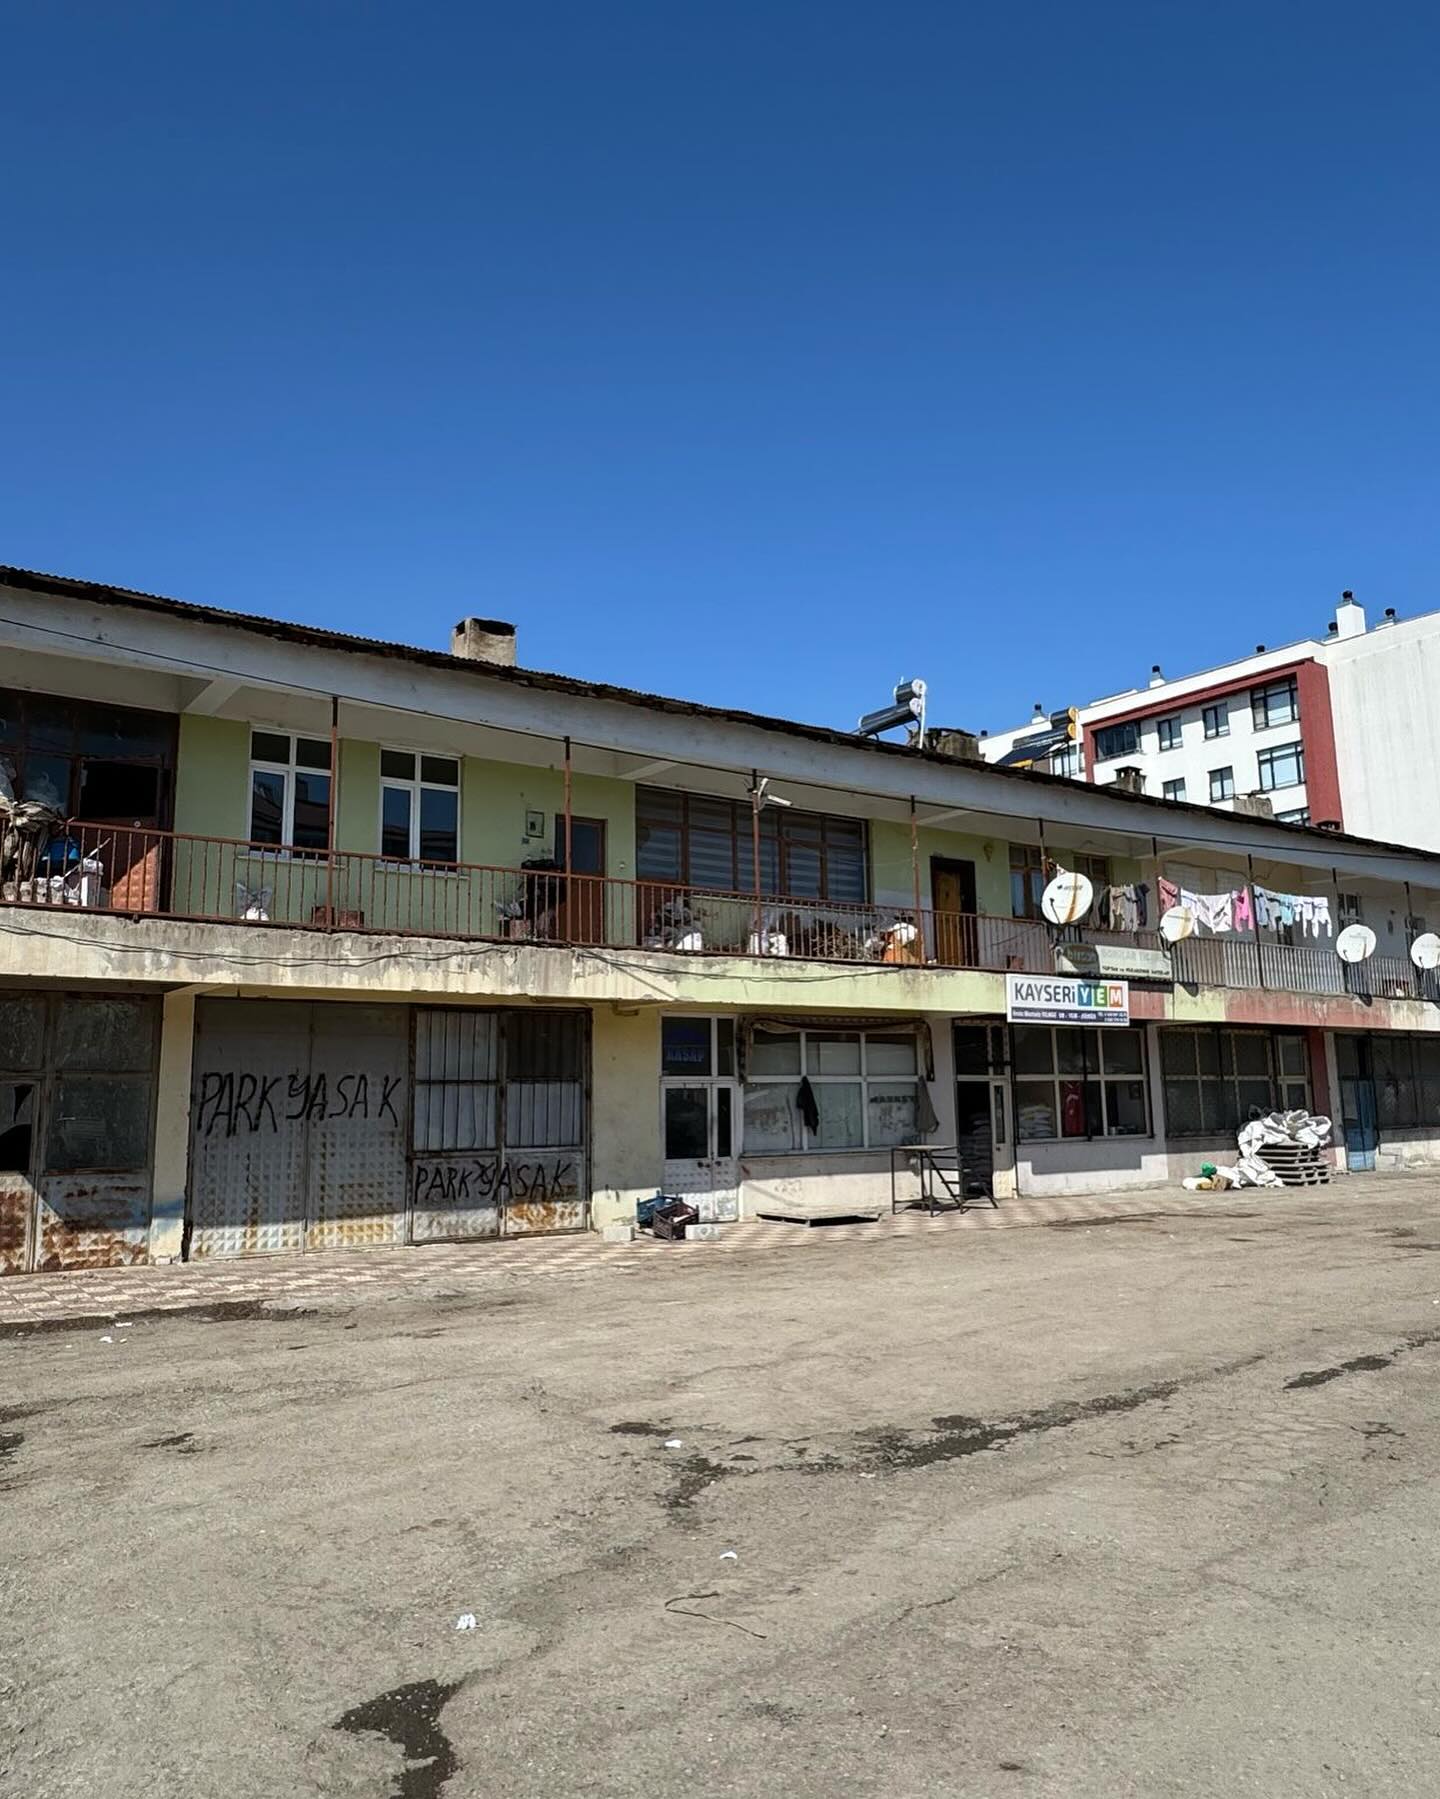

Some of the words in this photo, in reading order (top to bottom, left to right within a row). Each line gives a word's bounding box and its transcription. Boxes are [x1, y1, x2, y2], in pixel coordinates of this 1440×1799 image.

[1080, 986, 1122, 1006] YEM
[198, 1071, 281, 1138] PARK
[285, 1069, 401, 1128] YASAK
[414, 1164, 473, 1204] PARK
[474, 1159, 573, 1199] YASAK
